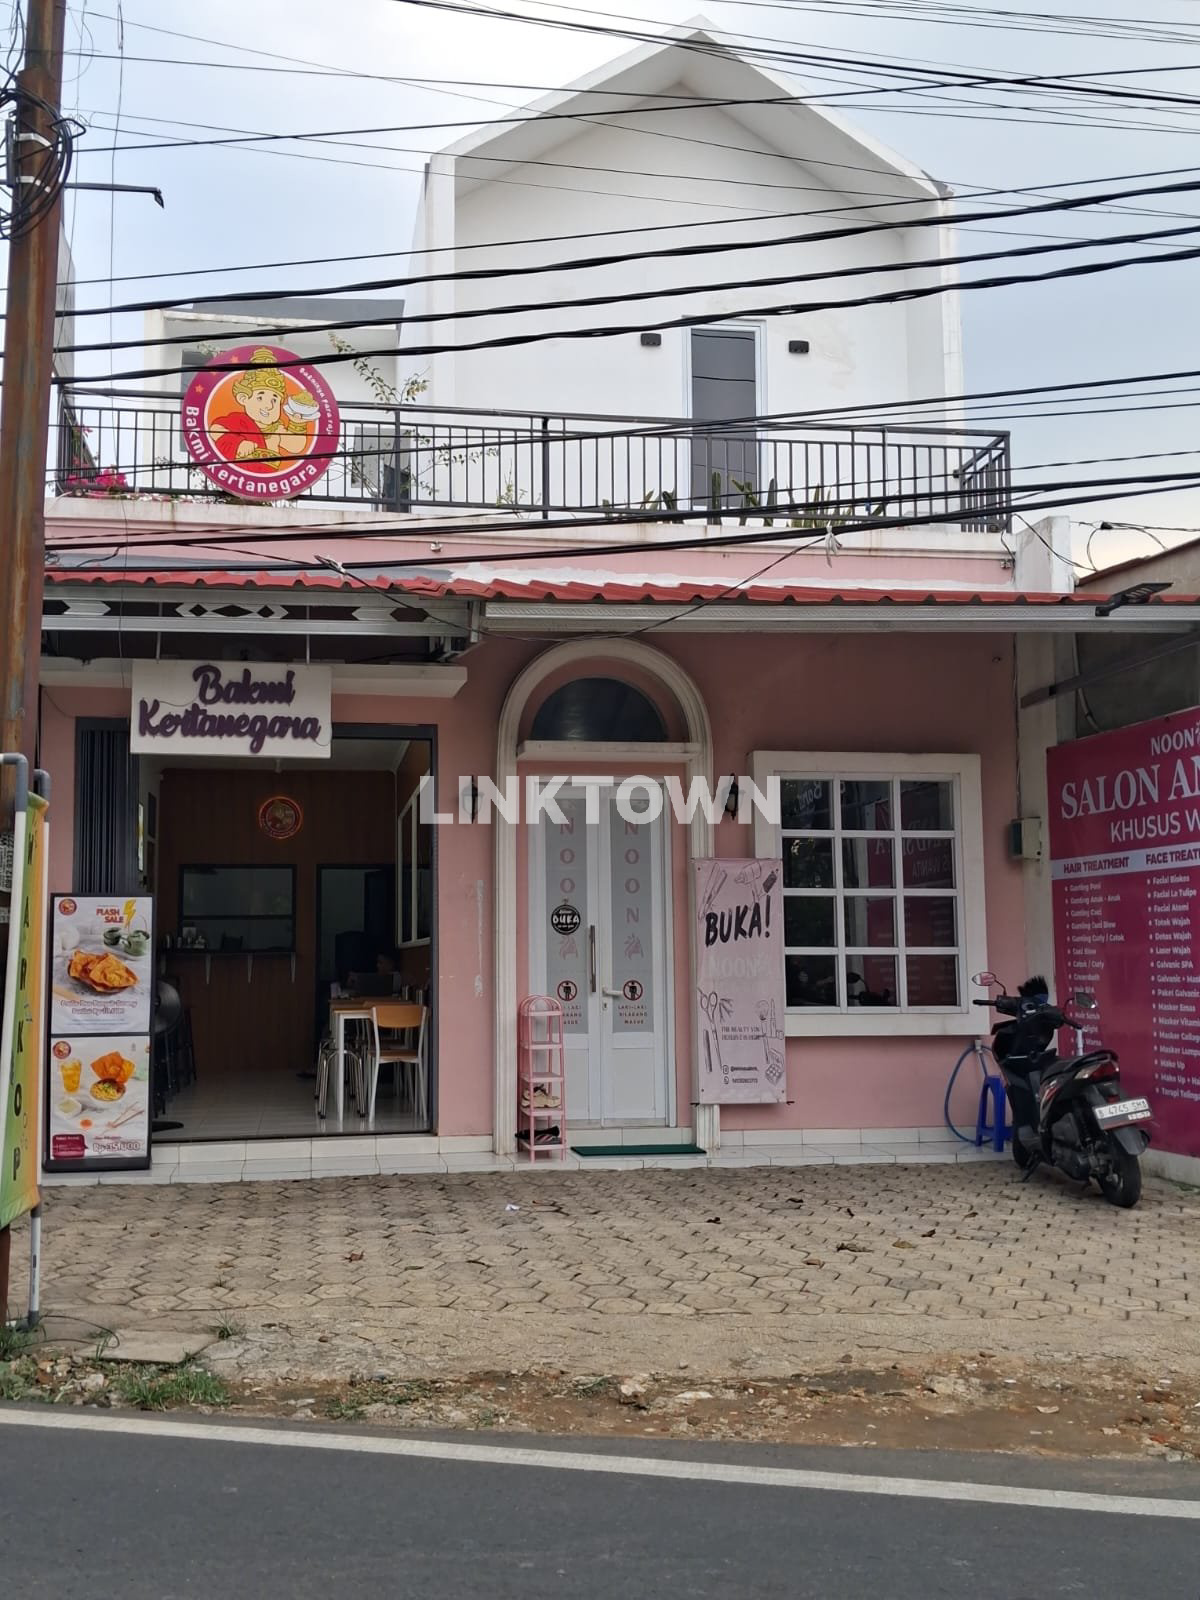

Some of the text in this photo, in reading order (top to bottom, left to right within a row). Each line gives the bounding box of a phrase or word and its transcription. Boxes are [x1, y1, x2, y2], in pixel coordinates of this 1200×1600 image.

[185, 406, 211, 461] Bakmi
[207, 458, 318, 494] Kertanegara
[192, 664, 296, 705] Bakmi
[138, 698, 321, 754] Kertanegara
[1061, 764, 1160, 820] SALON
[1110, 811, 1181, 843] KHUSUS
[1063, 857, 1129, 874] HAIR TREATMENT
[1145, 847, 1200, 865] FACE TREAT
[96, 908, 120, 916] FLASH
[104, 916, 124, 924] SALE
[705, 894, 771, 948] BUKA!
